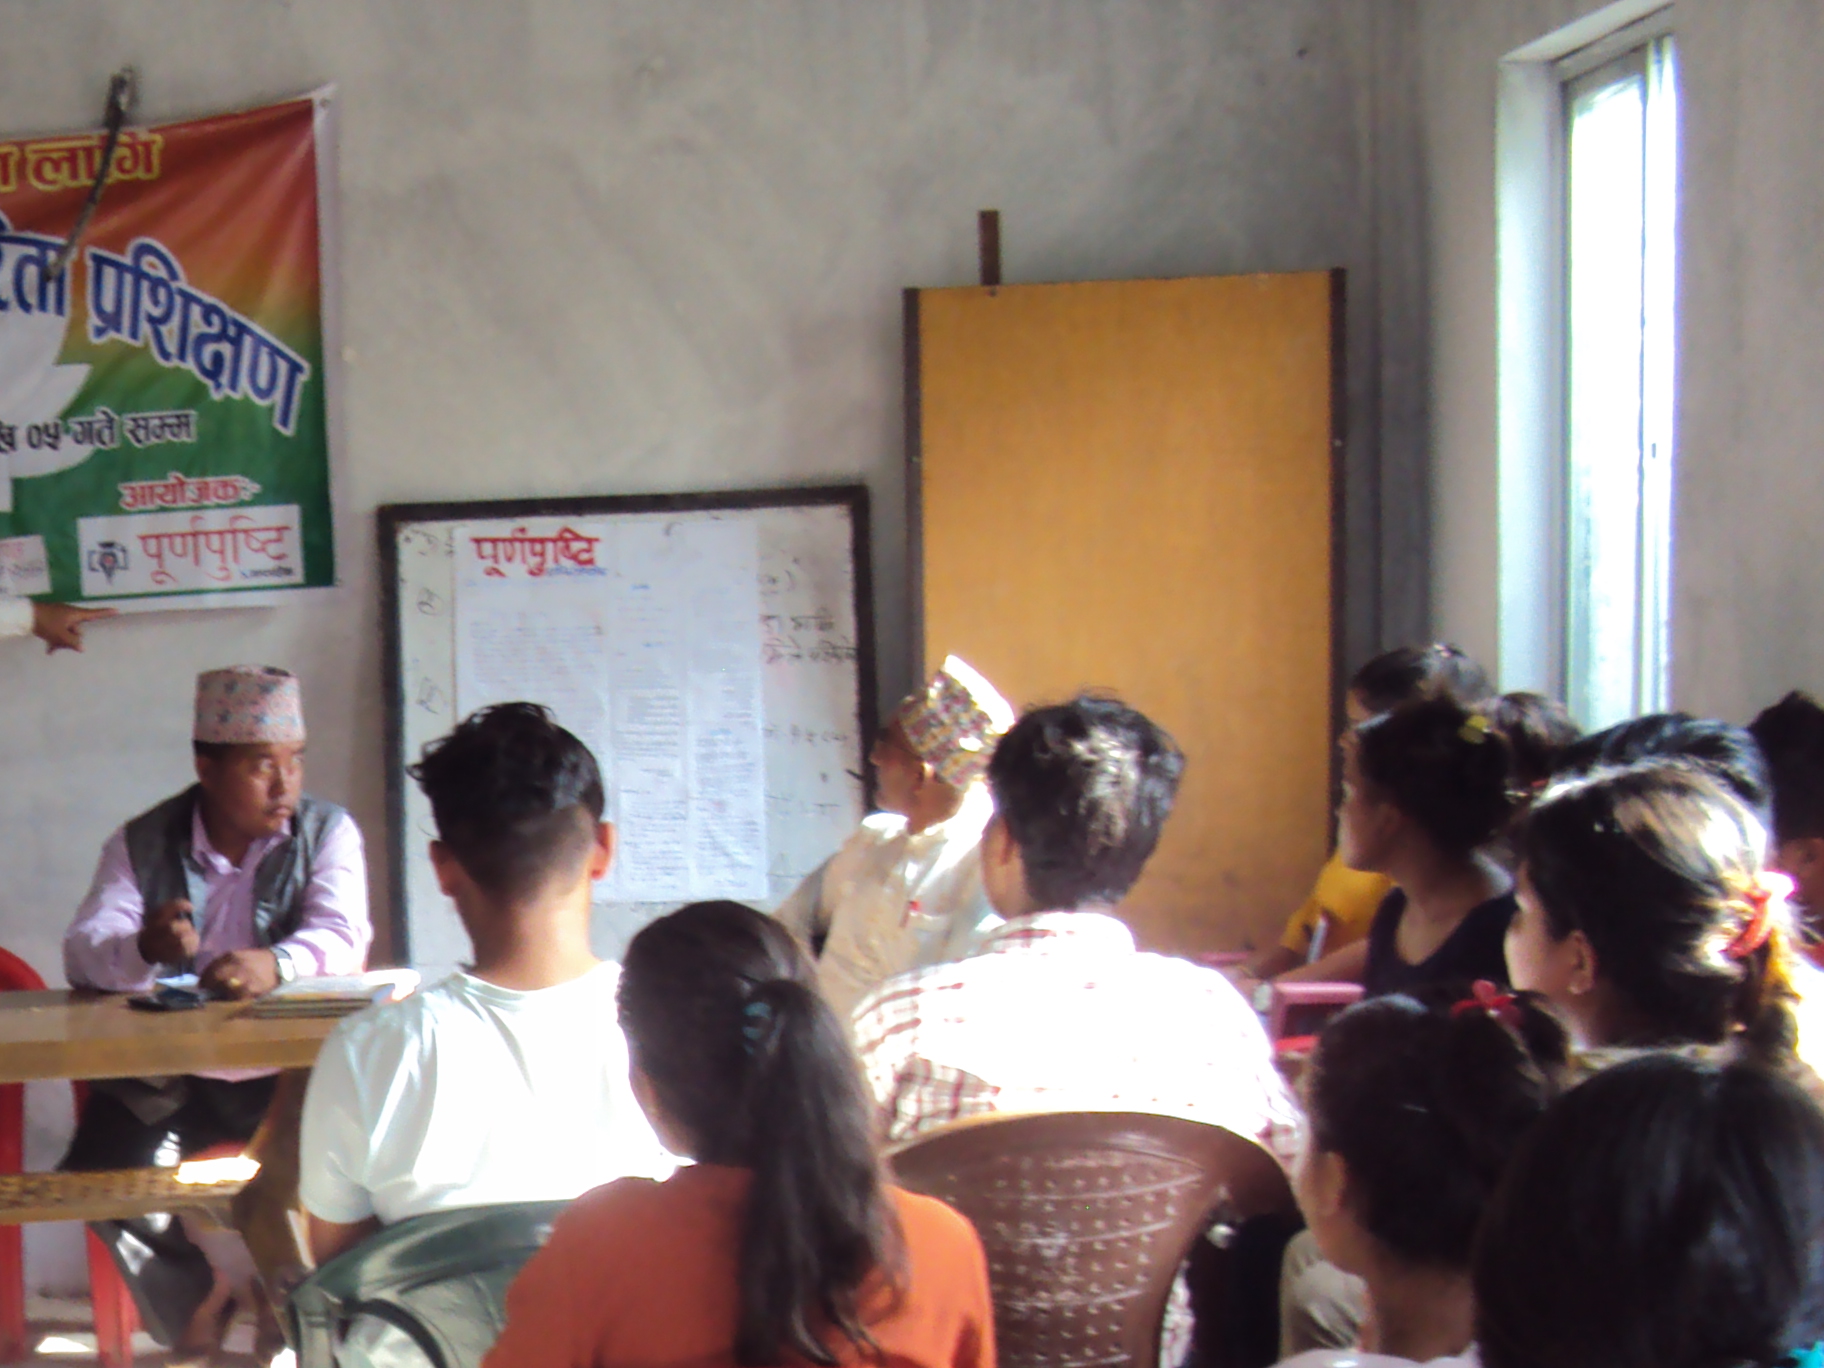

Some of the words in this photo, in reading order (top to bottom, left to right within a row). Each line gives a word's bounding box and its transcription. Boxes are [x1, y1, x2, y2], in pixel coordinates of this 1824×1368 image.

[87, 237, 310, 434] प्रशिक्षण
[69, 406, 118, 449] गते
[126, 410, 197, 447] सम्म
[137, 515, 292, 585] पूर्णपुष्टि
